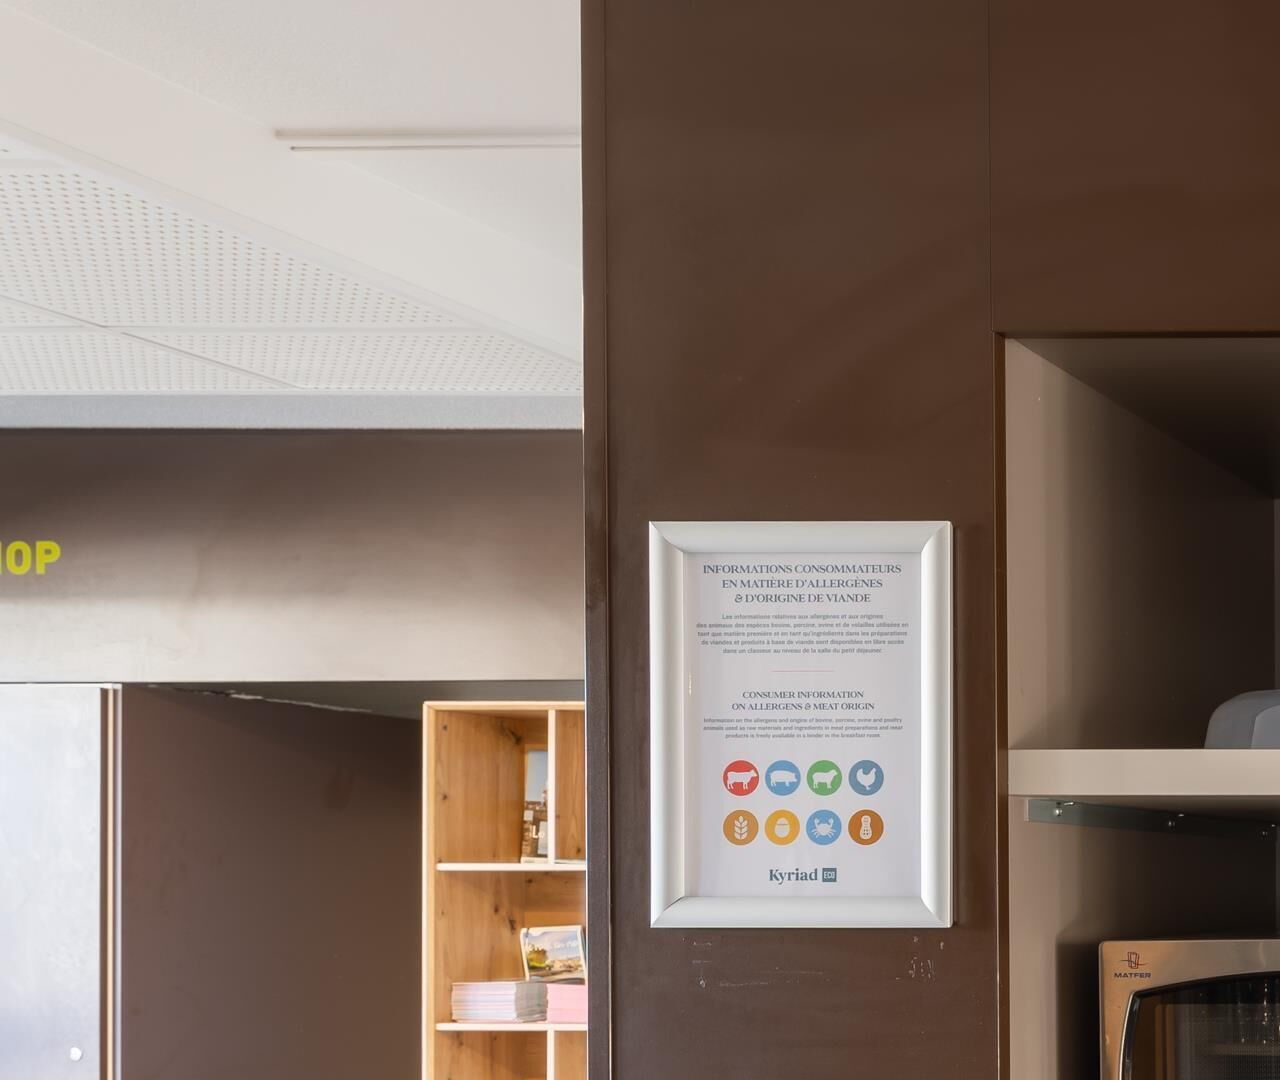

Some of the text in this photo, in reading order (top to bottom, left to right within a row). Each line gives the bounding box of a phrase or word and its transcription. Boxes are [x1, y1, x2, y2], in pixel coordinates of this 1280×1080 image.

[703, 565, 902, 574] INFORMATIONS CONSOMMATEURS
[722, 579, 737, 588] EN
[740, 577, 793, 588] MATIÈRE
[734, 594, 871, 603] & D'ORIGINE DE VIANDE
[742, 691, 864, 699] CONSUMER INFORMATION
[769, 868, 818, 885] Kyriad
